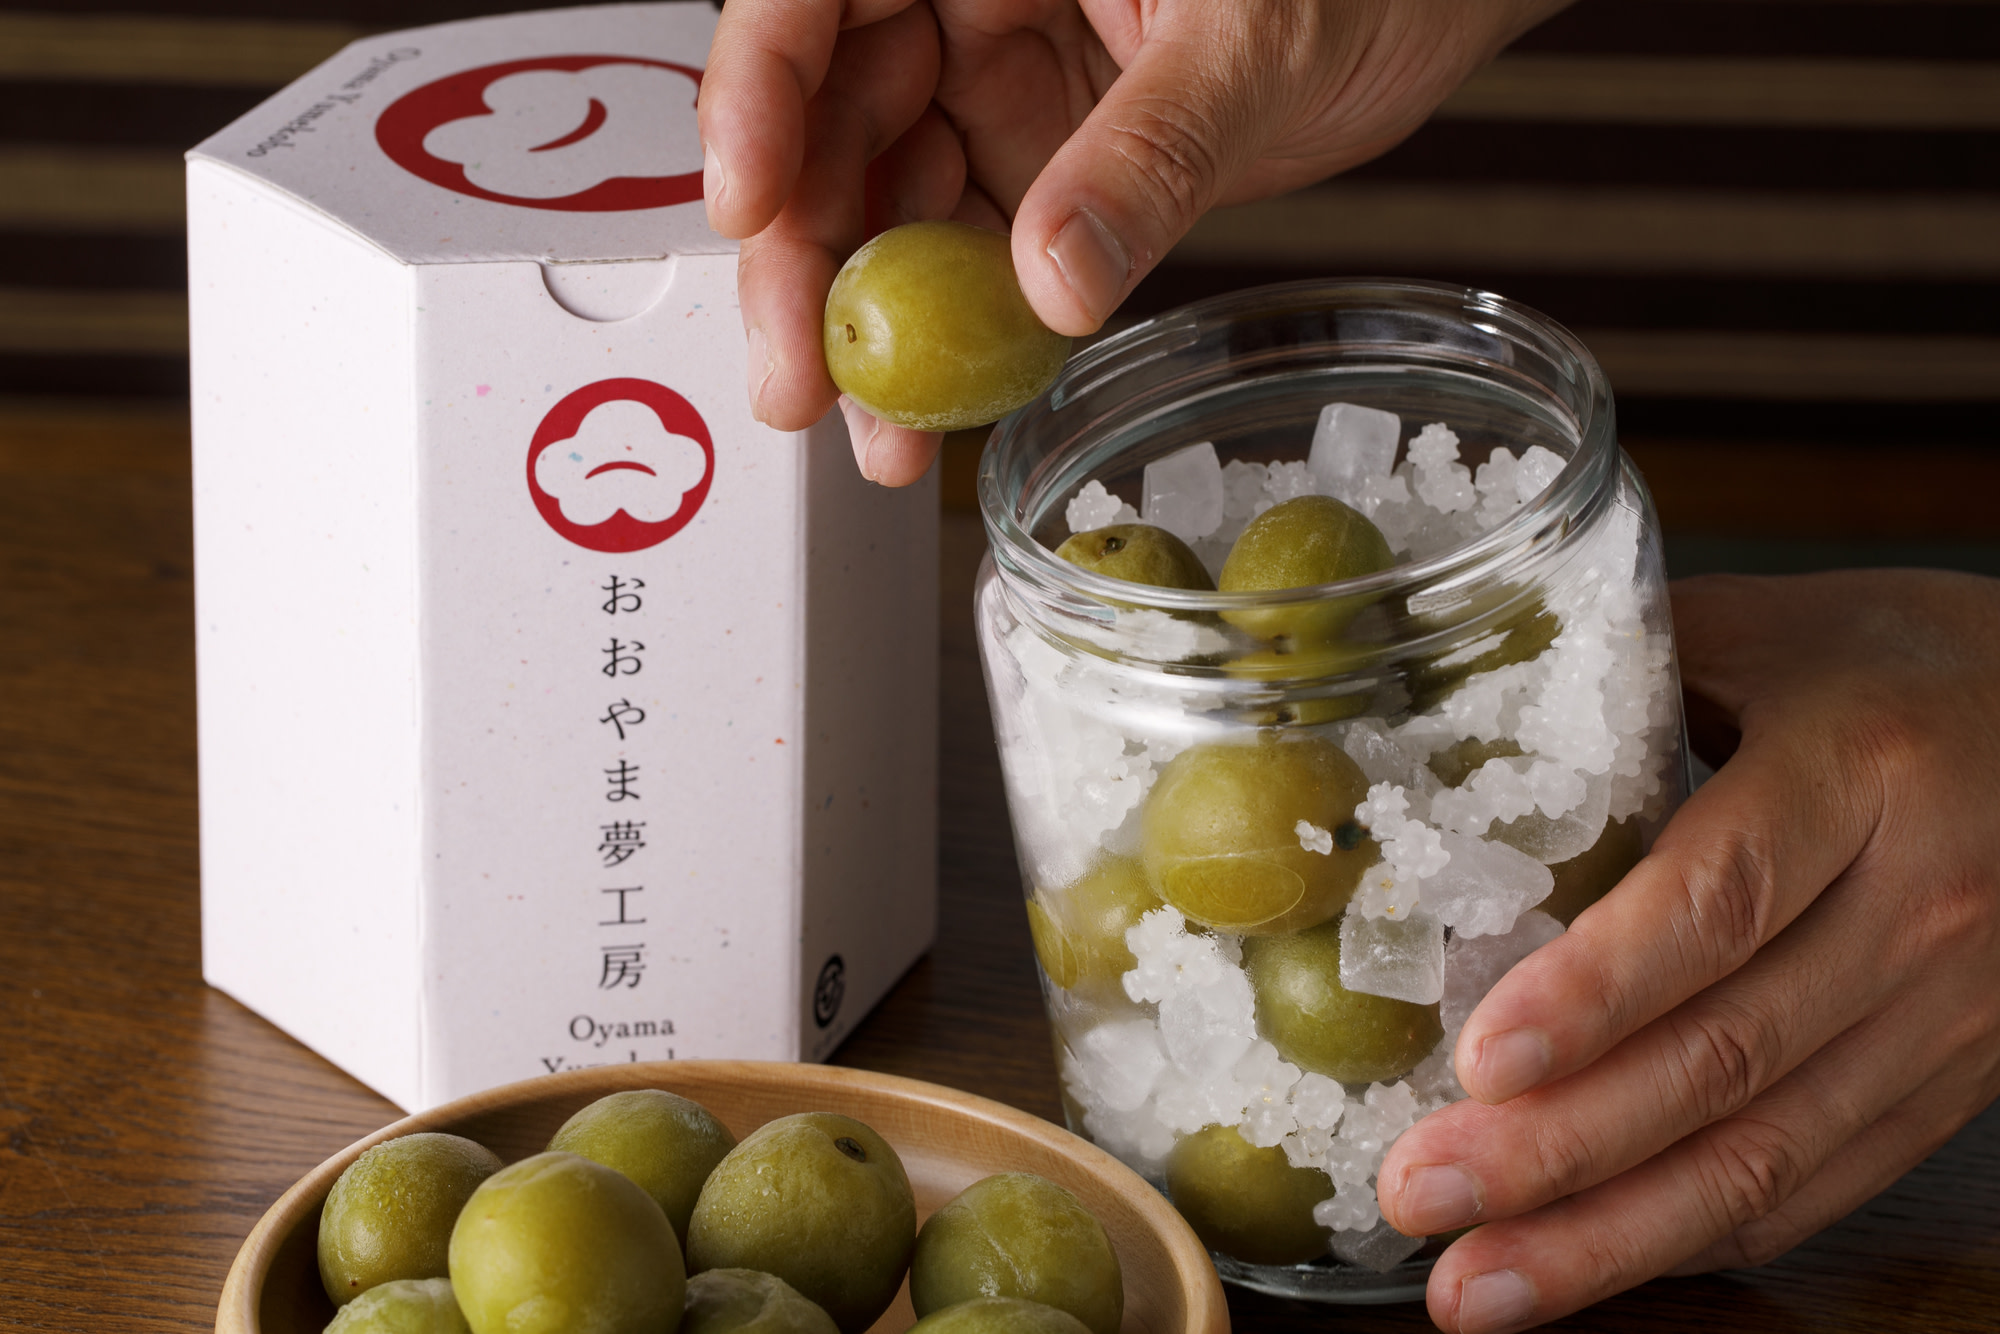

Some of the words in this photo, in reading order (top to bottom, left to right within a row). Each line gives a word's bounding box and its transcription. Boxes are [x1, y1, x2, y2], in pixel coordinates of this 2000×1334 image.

[598, 574, 647, 990] おおやま夢工房
[568, 1014, 676, 1048] Oyama
